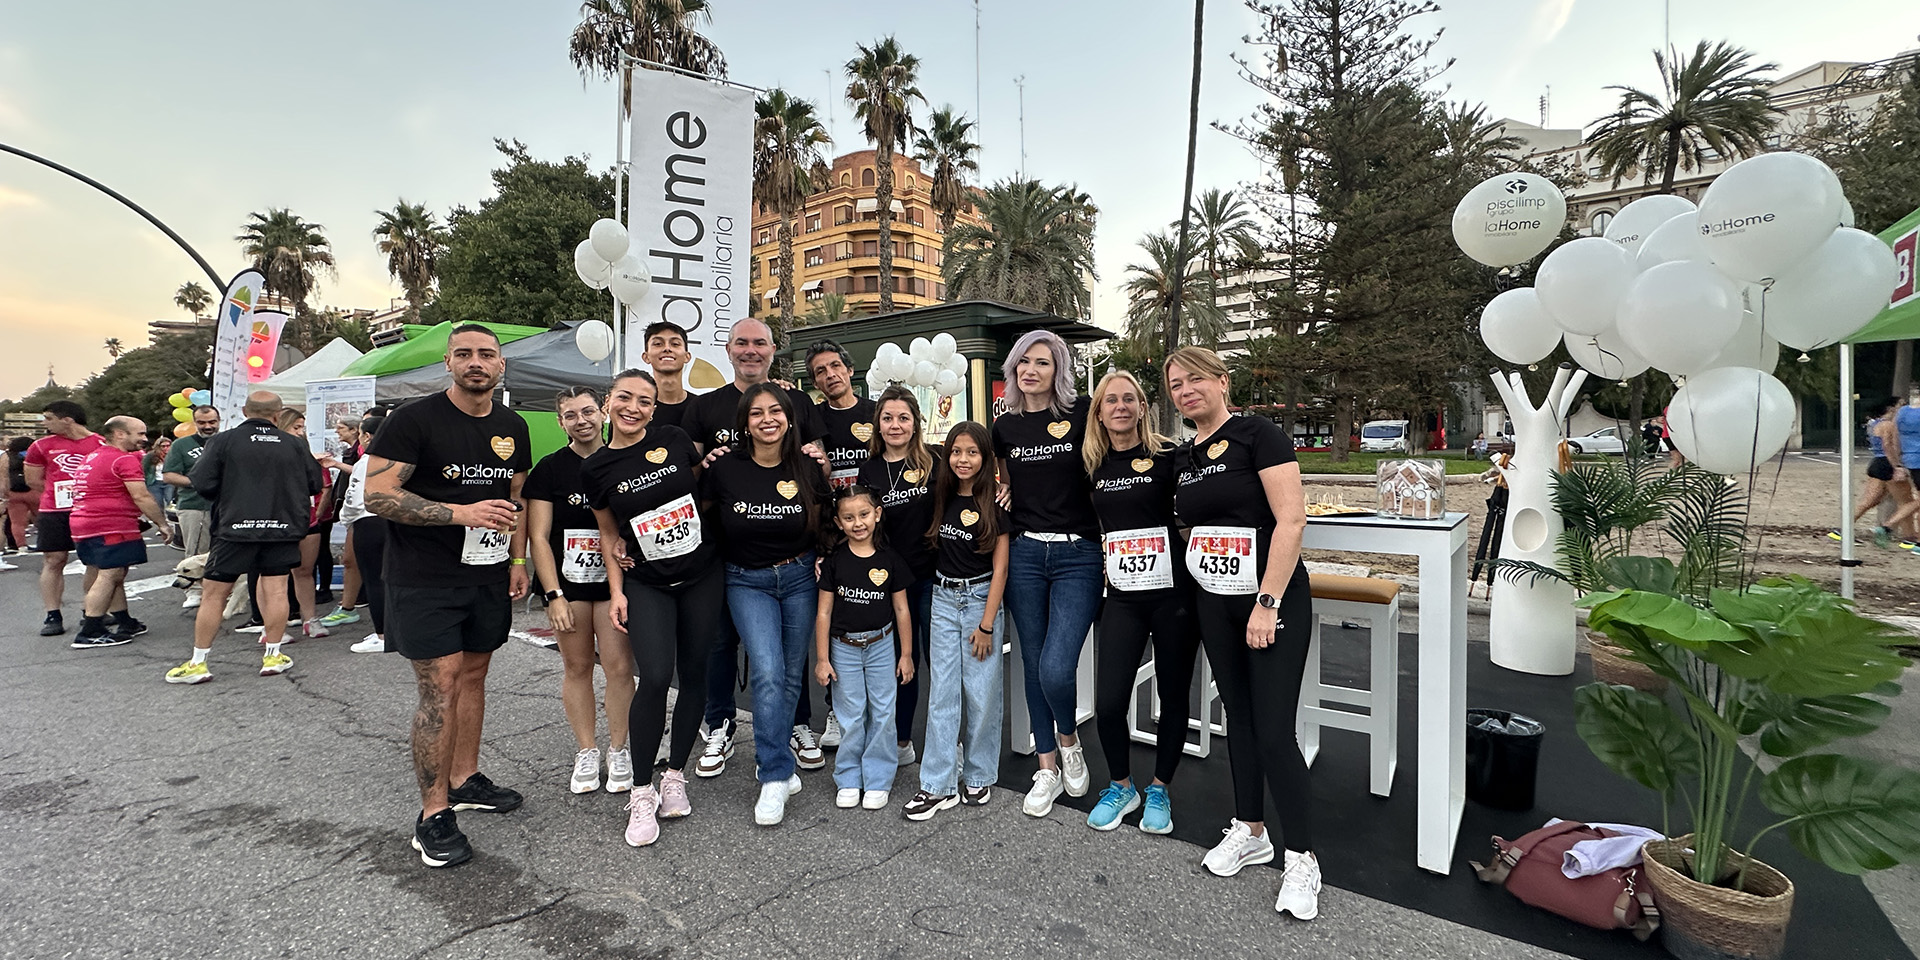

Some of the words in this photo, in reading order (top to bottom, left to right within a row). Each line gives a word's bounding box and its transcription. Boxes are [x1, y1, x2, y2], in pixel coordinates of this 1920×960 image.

[1487, 197, 1546, 214] piscilimp
[1489, 209, 1515, 218] grupo
[649, 111, 708, 345] aHome
[1485, 219, 1541, 232] laHome
[1710, 213, 1775, 233] laHome
[710, 215, 733, 347] inmobiliaria
[826, 447, 871, 461] aHom
[1022, 443, 1073, 457] laHome
[628, 464, 678, 489] laHome
[1104, 475, 1152, 488] laHome
[881, 486, 928, 503] aHome
[747, 503, 803, 515] laHome
[479, 531, 507, 548] 4340
[654, 521, 690, 546] 4338
[939, 523, 973, 541] aHome
[575, 552, 607, 568] 433
[1118, 554, 1157, 573] 4337
[1199, 555, 1240, 575] 4339
[844, 586, 885, 600] laHome
